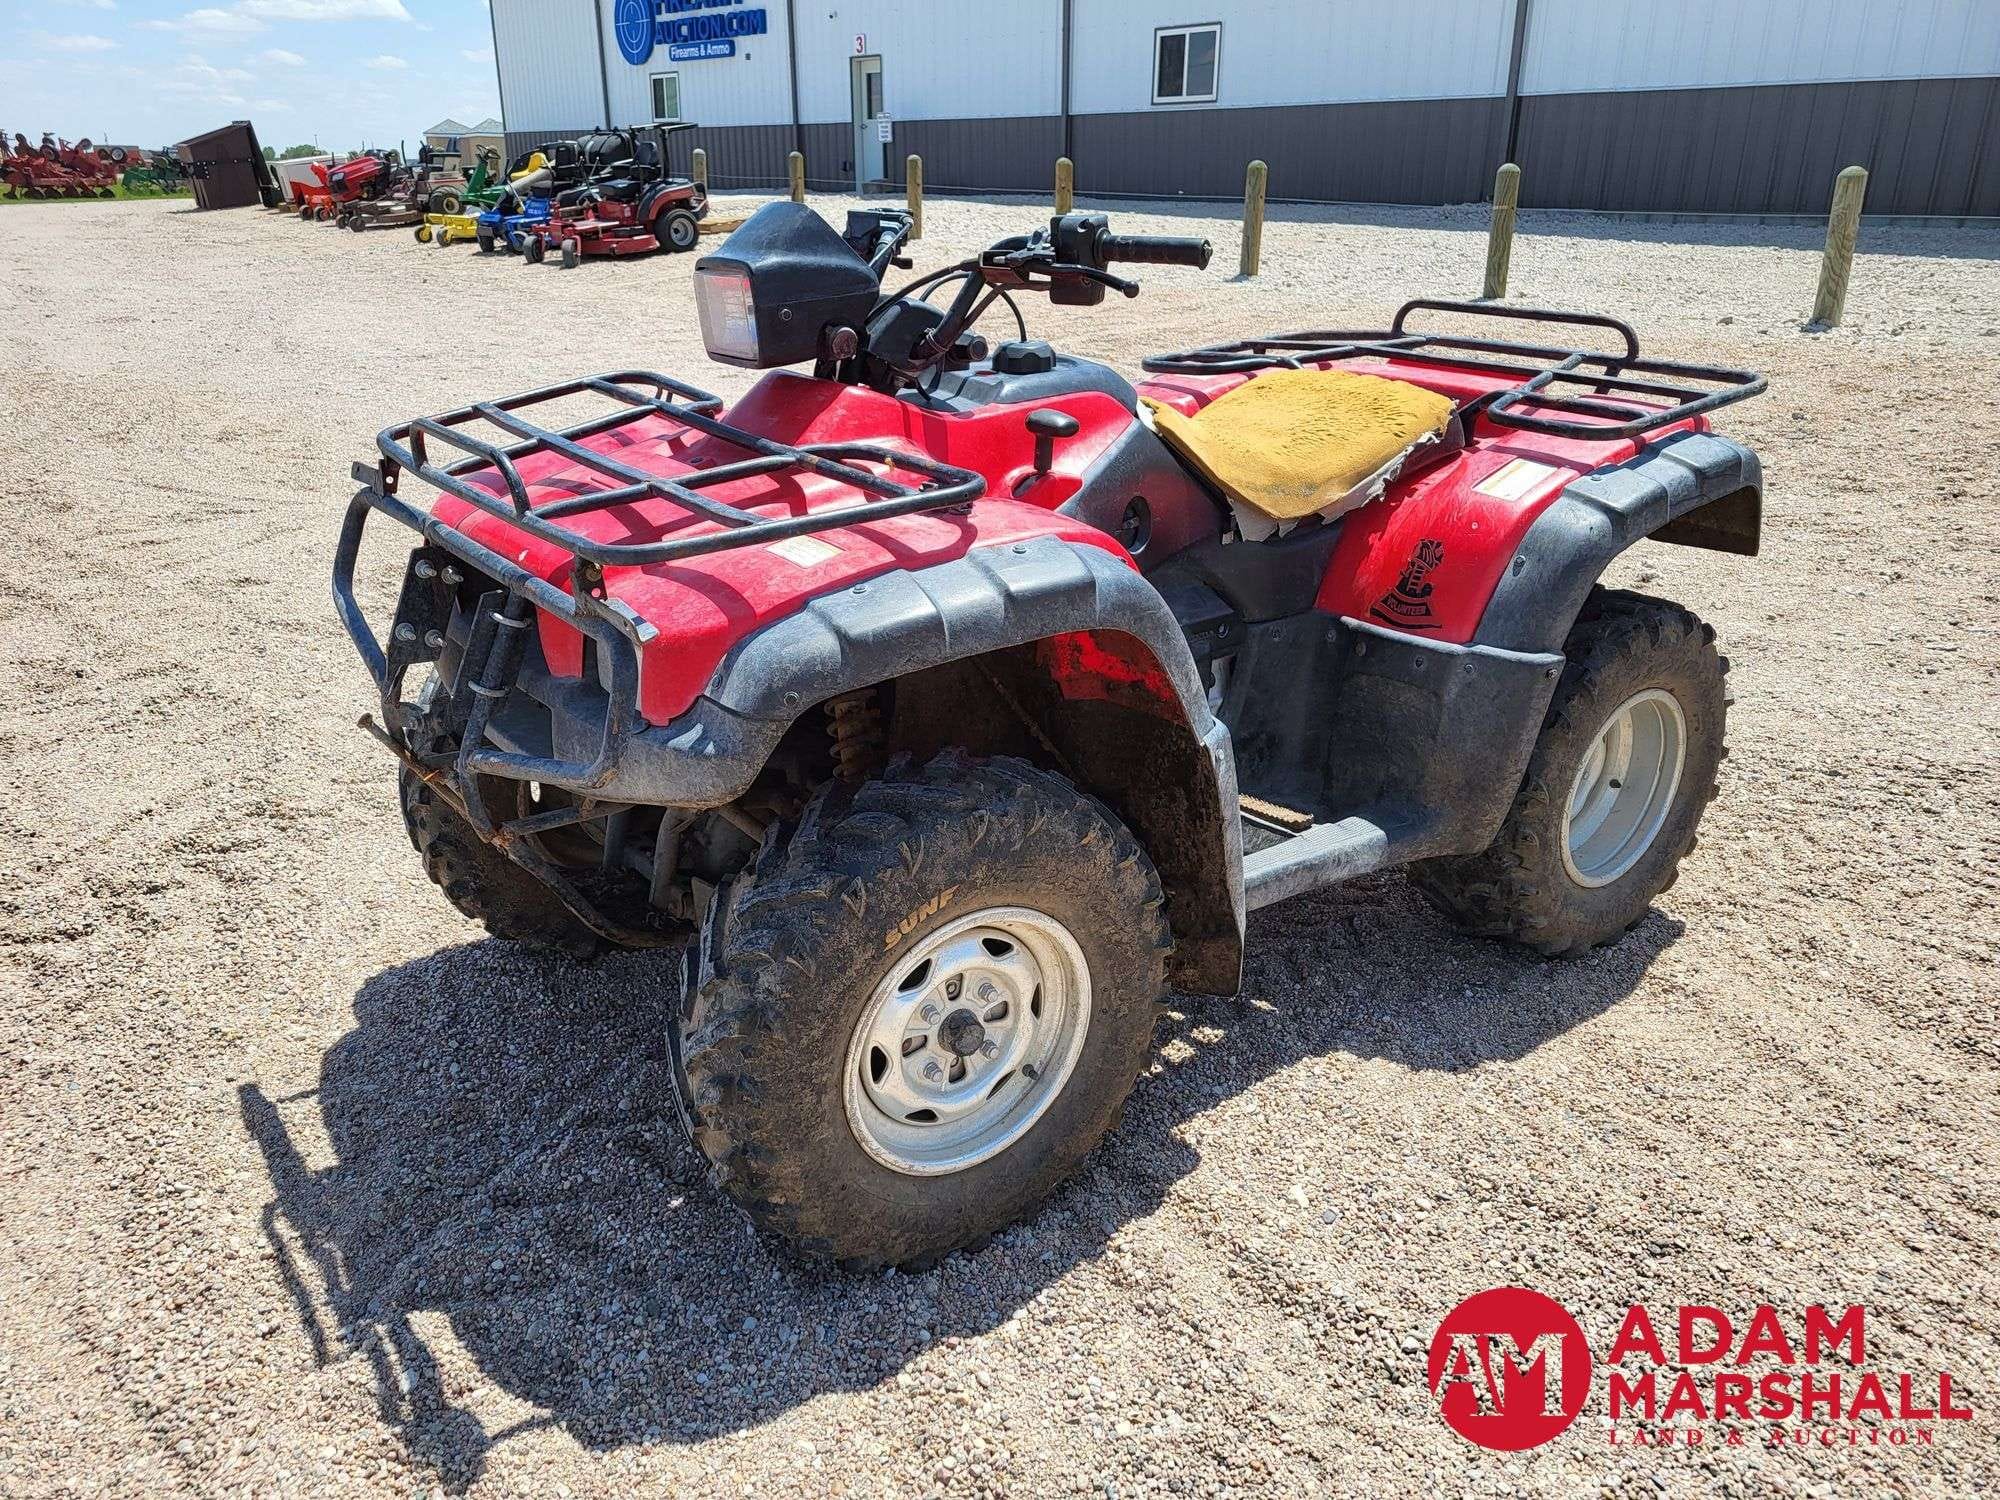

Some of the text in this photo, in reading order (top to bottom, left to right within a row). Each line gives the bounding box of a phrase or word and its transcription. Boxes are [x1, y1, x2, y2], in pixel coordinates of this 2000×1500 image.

[655, 9, 766, 44] AUCTION.COM
[670, 43, 730, 59] Firearms & Ammo
[855, 36, 864, 54] 3
[1387, 597, 1426, 615] VOLUNTEER
[882, 884, 961, 953] SUNF
